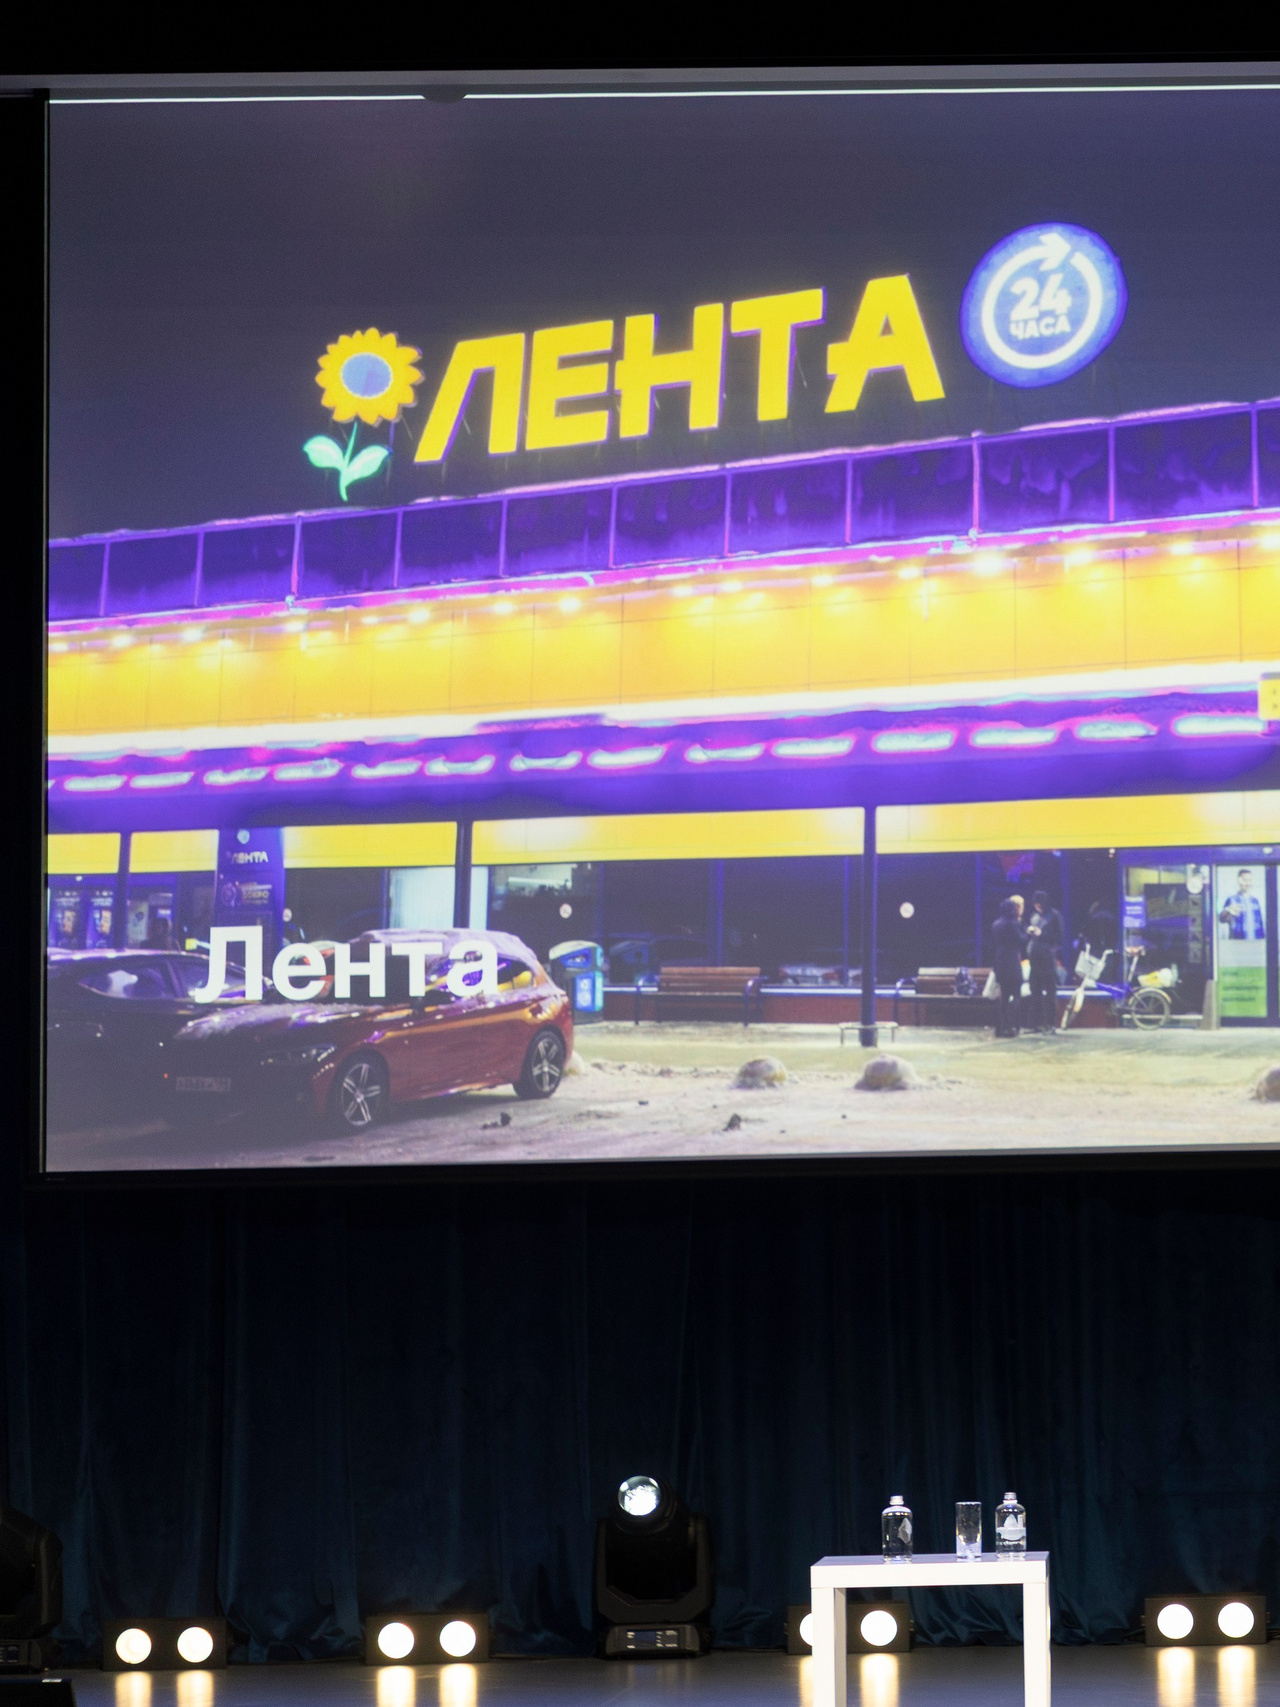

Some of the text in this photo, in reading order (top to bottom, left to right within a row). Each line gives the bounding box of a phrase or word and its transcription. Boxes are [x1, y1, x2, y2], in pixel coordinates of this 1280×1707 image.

[1010, 273, 1072, 321] 24
[1010, 314, 1071, 340] ЧАСА
[414, 273, 945, 463] ЛЕНТА
[194, 925, 499, 1004] Лента
